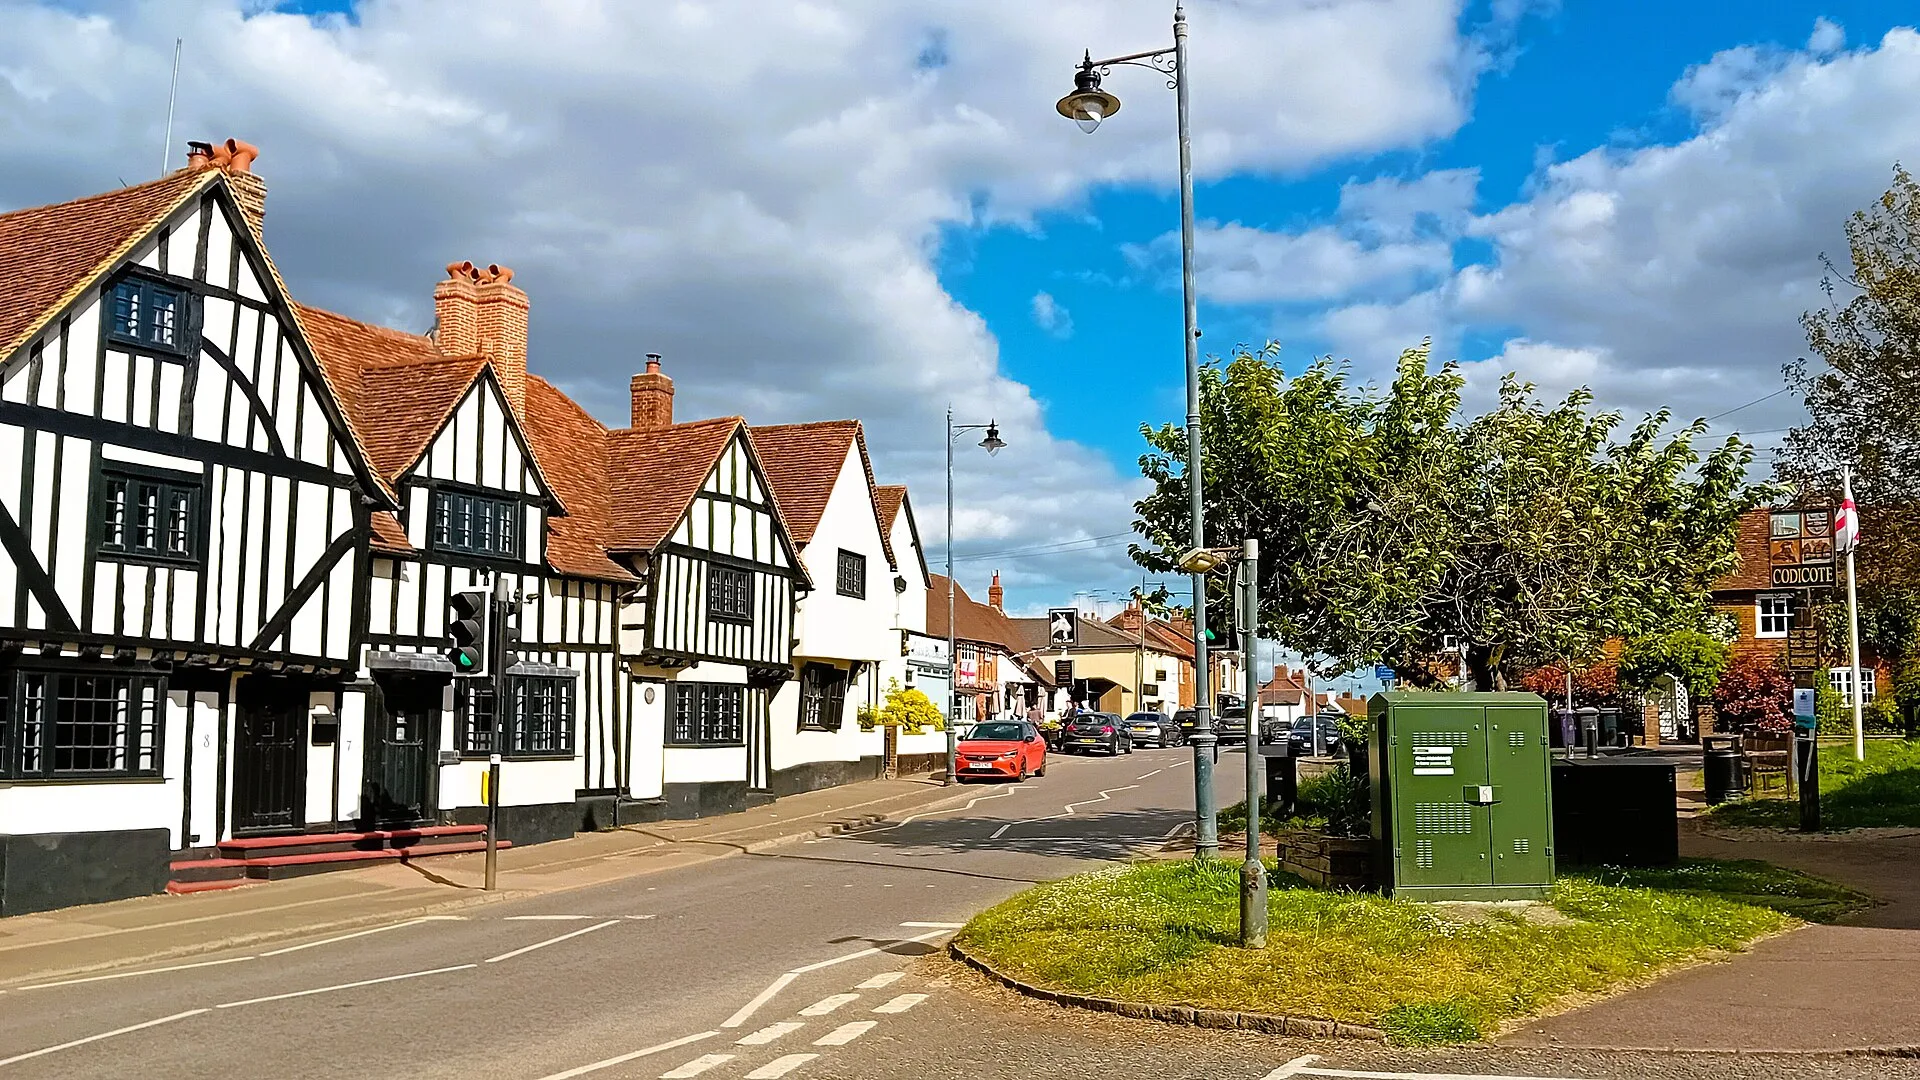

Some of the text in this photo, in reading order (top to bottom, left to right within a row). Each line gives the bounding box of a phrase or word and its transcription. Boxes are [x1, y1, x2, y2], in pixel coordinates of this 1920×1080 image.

[1773, 566, 1833, 584] CODICOTE
[203, 734, 210, 748] 8
[346, 740, 352, 752] 7
